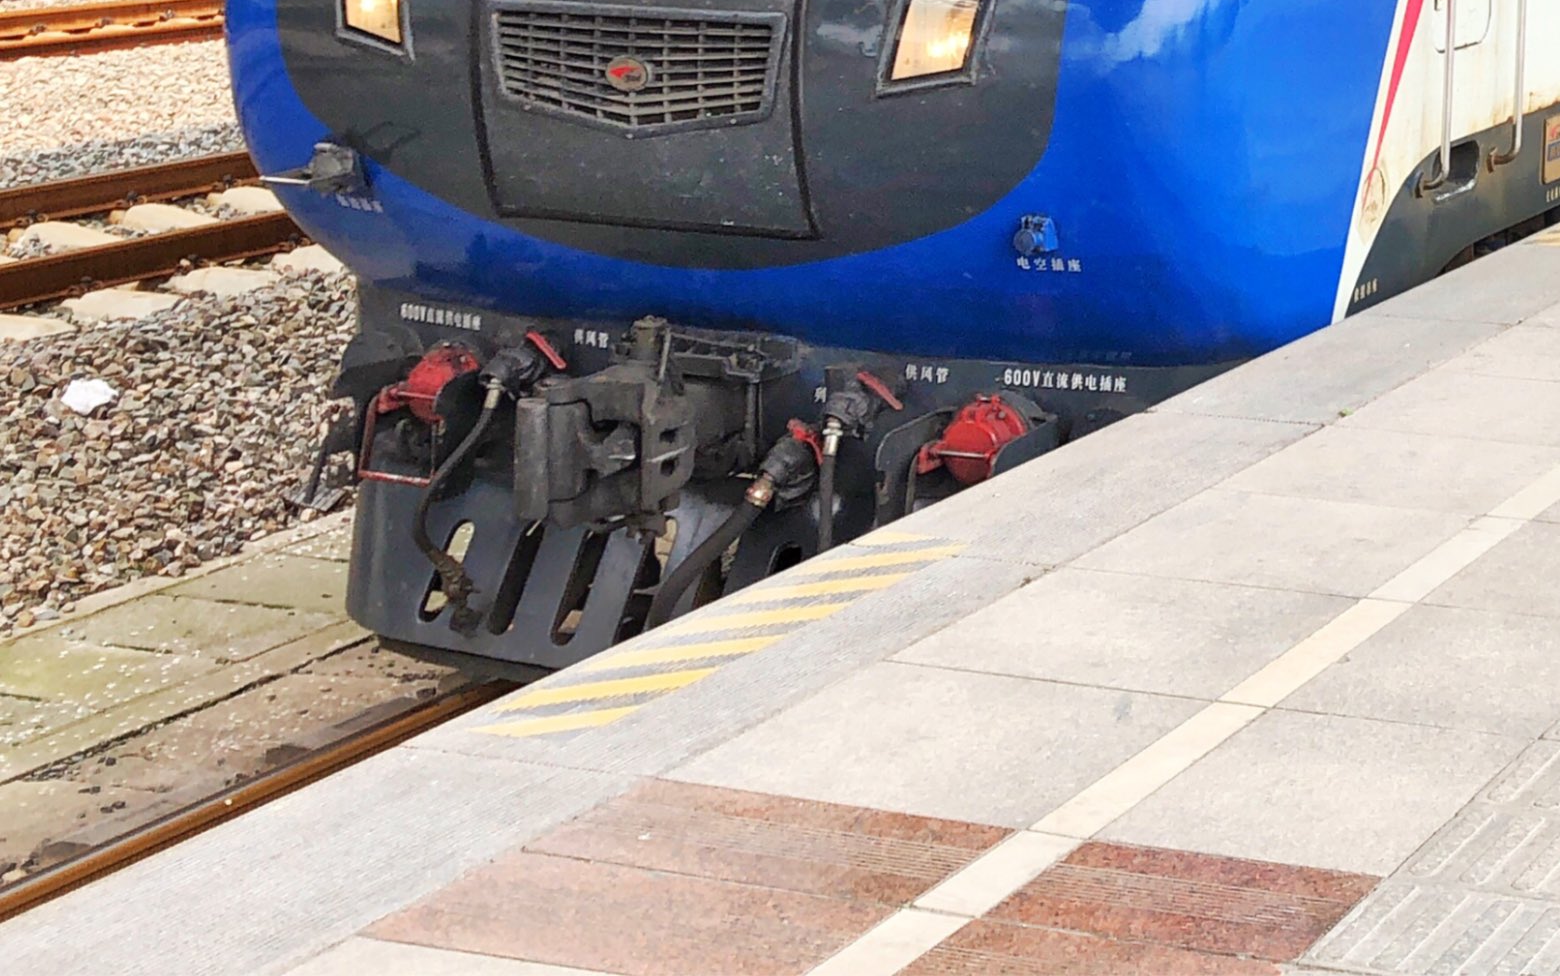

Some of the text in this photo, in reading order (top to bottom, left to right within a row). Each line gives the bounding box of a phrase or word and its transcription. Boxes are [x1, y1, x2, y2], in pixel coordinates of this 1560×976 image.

[1016, 255, 1081, 272] 电空插座
[905, 363, 949, 384] 供风管
[1004, 368, 1127, 393] 600V直流供电插座
